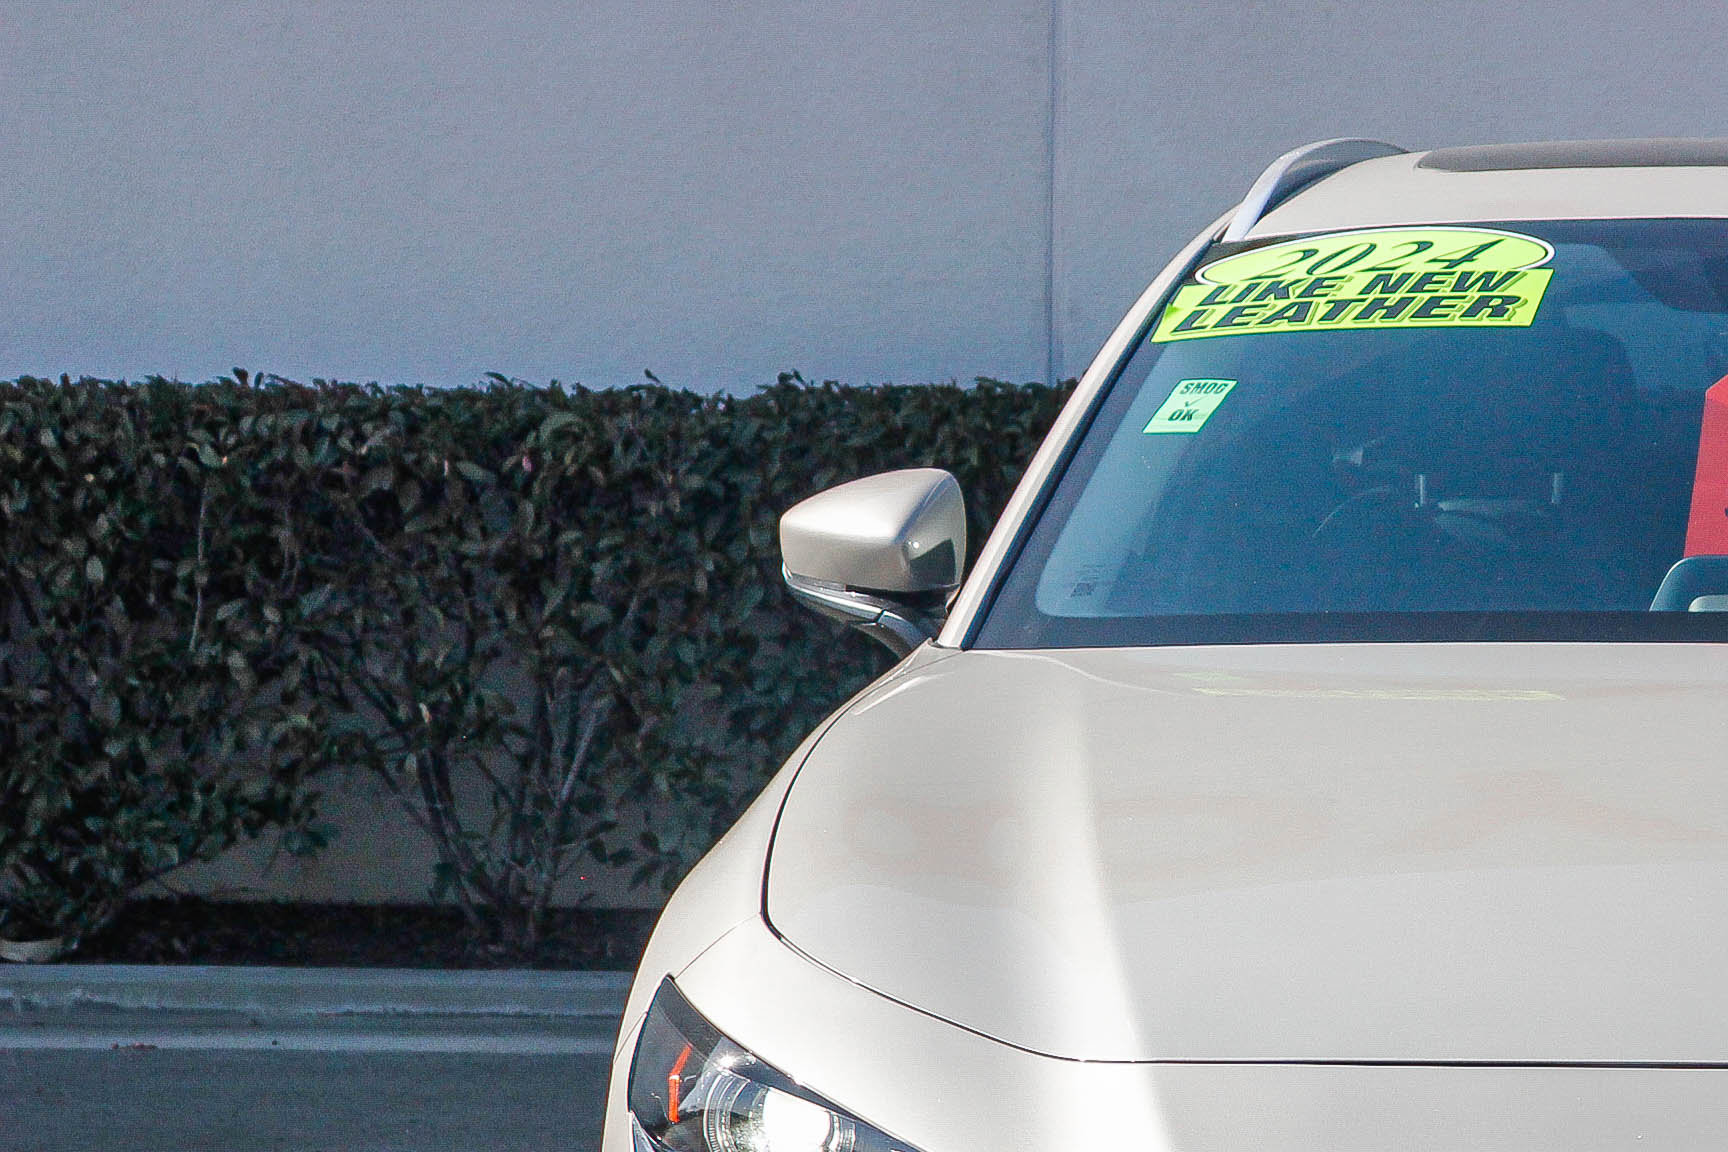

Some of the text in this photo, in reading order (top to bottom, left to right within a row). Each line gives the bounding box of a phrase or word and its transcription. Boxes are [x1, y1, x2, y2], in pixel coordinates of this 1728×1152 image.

[1243, 237, 1506, 282] 2024
[1196, 270, 1522, 307] LIKE NEW
[1170, 294, 1528, 335] LEATHER
[1167, 408, 1199, 422] OK
